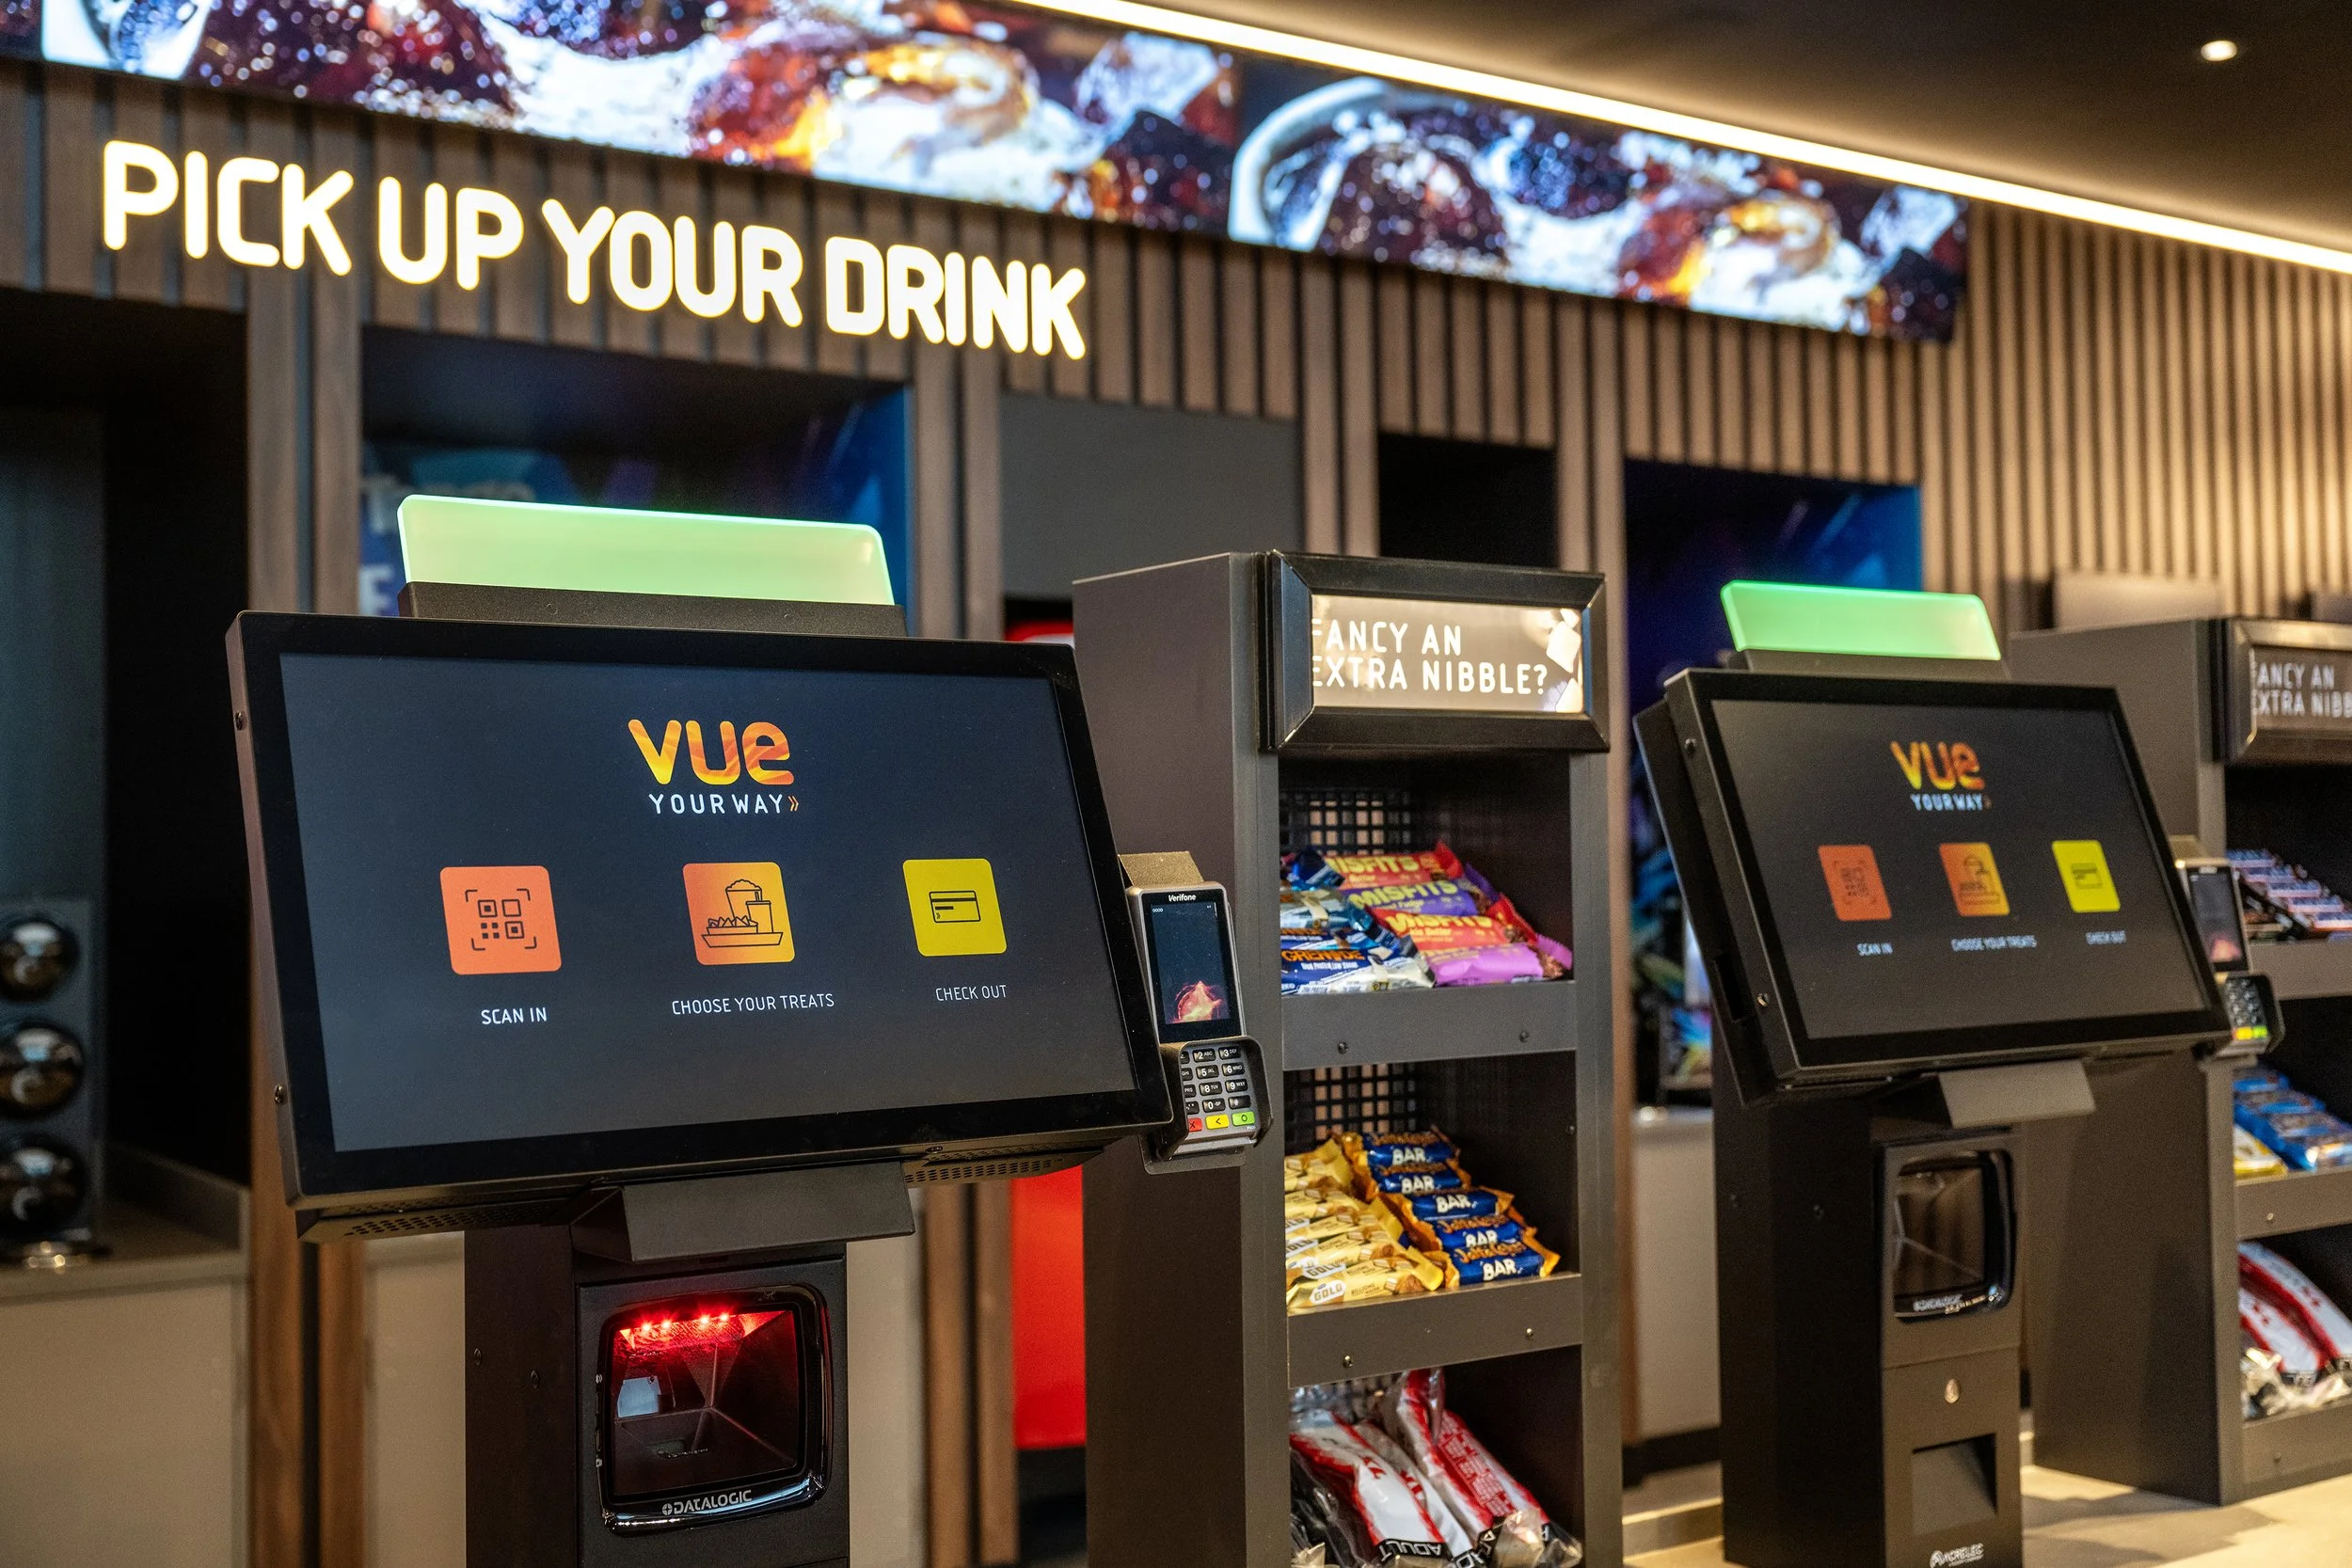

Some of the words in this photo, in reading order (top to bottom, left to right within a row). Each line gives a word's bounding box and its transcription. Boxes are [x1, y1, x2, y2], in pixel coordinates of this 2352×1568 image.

[102, 140, 355, 276] PICK
[378, 176, 524, 292] UP
[541, 198, 803, 328] YOUR
[825, 235, 1087, 360] DRINK
[1422, 624, 1462, 656] AN
[1422, 660, 1548, 695] NIBBLE?
[2311, 664, 2335, 689] AN
[1168, 894, 1197, 902] Verifone
[1348, 879, 1458, 910] MISFITS
[1857, 942, 1882, 956] SCAN
[1881, 942, 1894, 955] IN
[935, 985, 979, 1003] CHECK
[980, 984, 1009, 1001] OUT
[672, 997, 732, 1016] CHOOSE
[734, 994, 777, 1013] YOUR
[781, 992, 835, 1010] TREATS
[481, 1007, 525, 1025] SCAN
[529, 1006, 548, 1024] IN
[1198, 1051, 1204, 1060] 2
[1223, 1049, 1230, 1057] 3
[1204, 1085, 1211, 1093] 8
[1230, 1082, 1236, 1090] 9
[1208, 1101, 1214, 1110] 0
[1391, 1147, 1427, 1165] BAR
[1401, 1175, 1435, 1194] BAR
[1436, 1194, 1471, 1213] BAR
[1466, 1229, 1498, 1248] BAR
[1482, 1259, 1517, 1281] BAR
[1313, 1283, 1343, 1303] GOLD
[674, 1490, 753, 1515] DATALOGIC
[1378, 1540, 1442, 1562] ADULT
